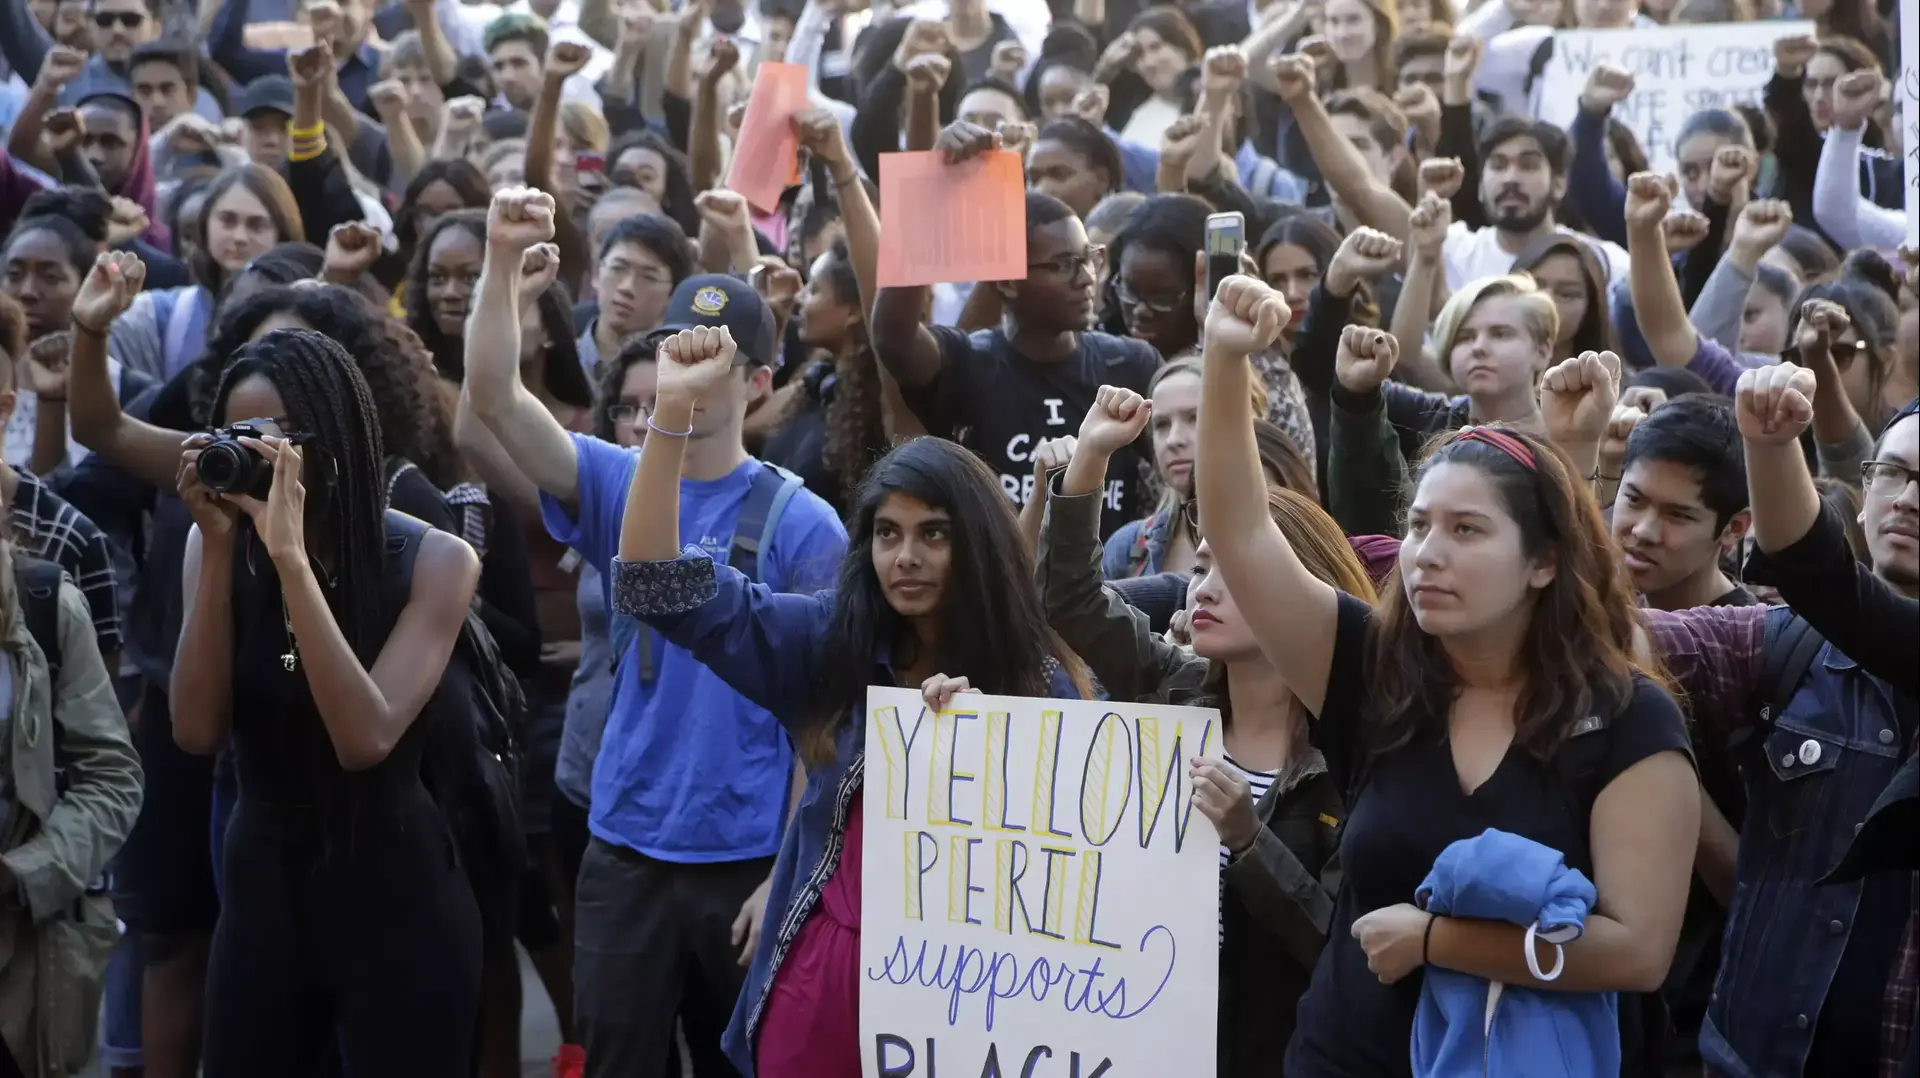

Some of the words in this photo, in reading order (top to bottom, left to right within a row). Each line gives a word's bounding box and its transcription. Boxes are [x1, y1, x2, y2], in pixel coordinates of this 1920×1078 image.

[1560, 38, 1611, 75] We
[1706, 44, 1771, 76] crea
[1043, 398, 1066, 425] I
[873, 706, 1213, 854] YELLOW
[904, 830, 1122, 949] PERIL
[868, 925, 1176, 1032] supports
